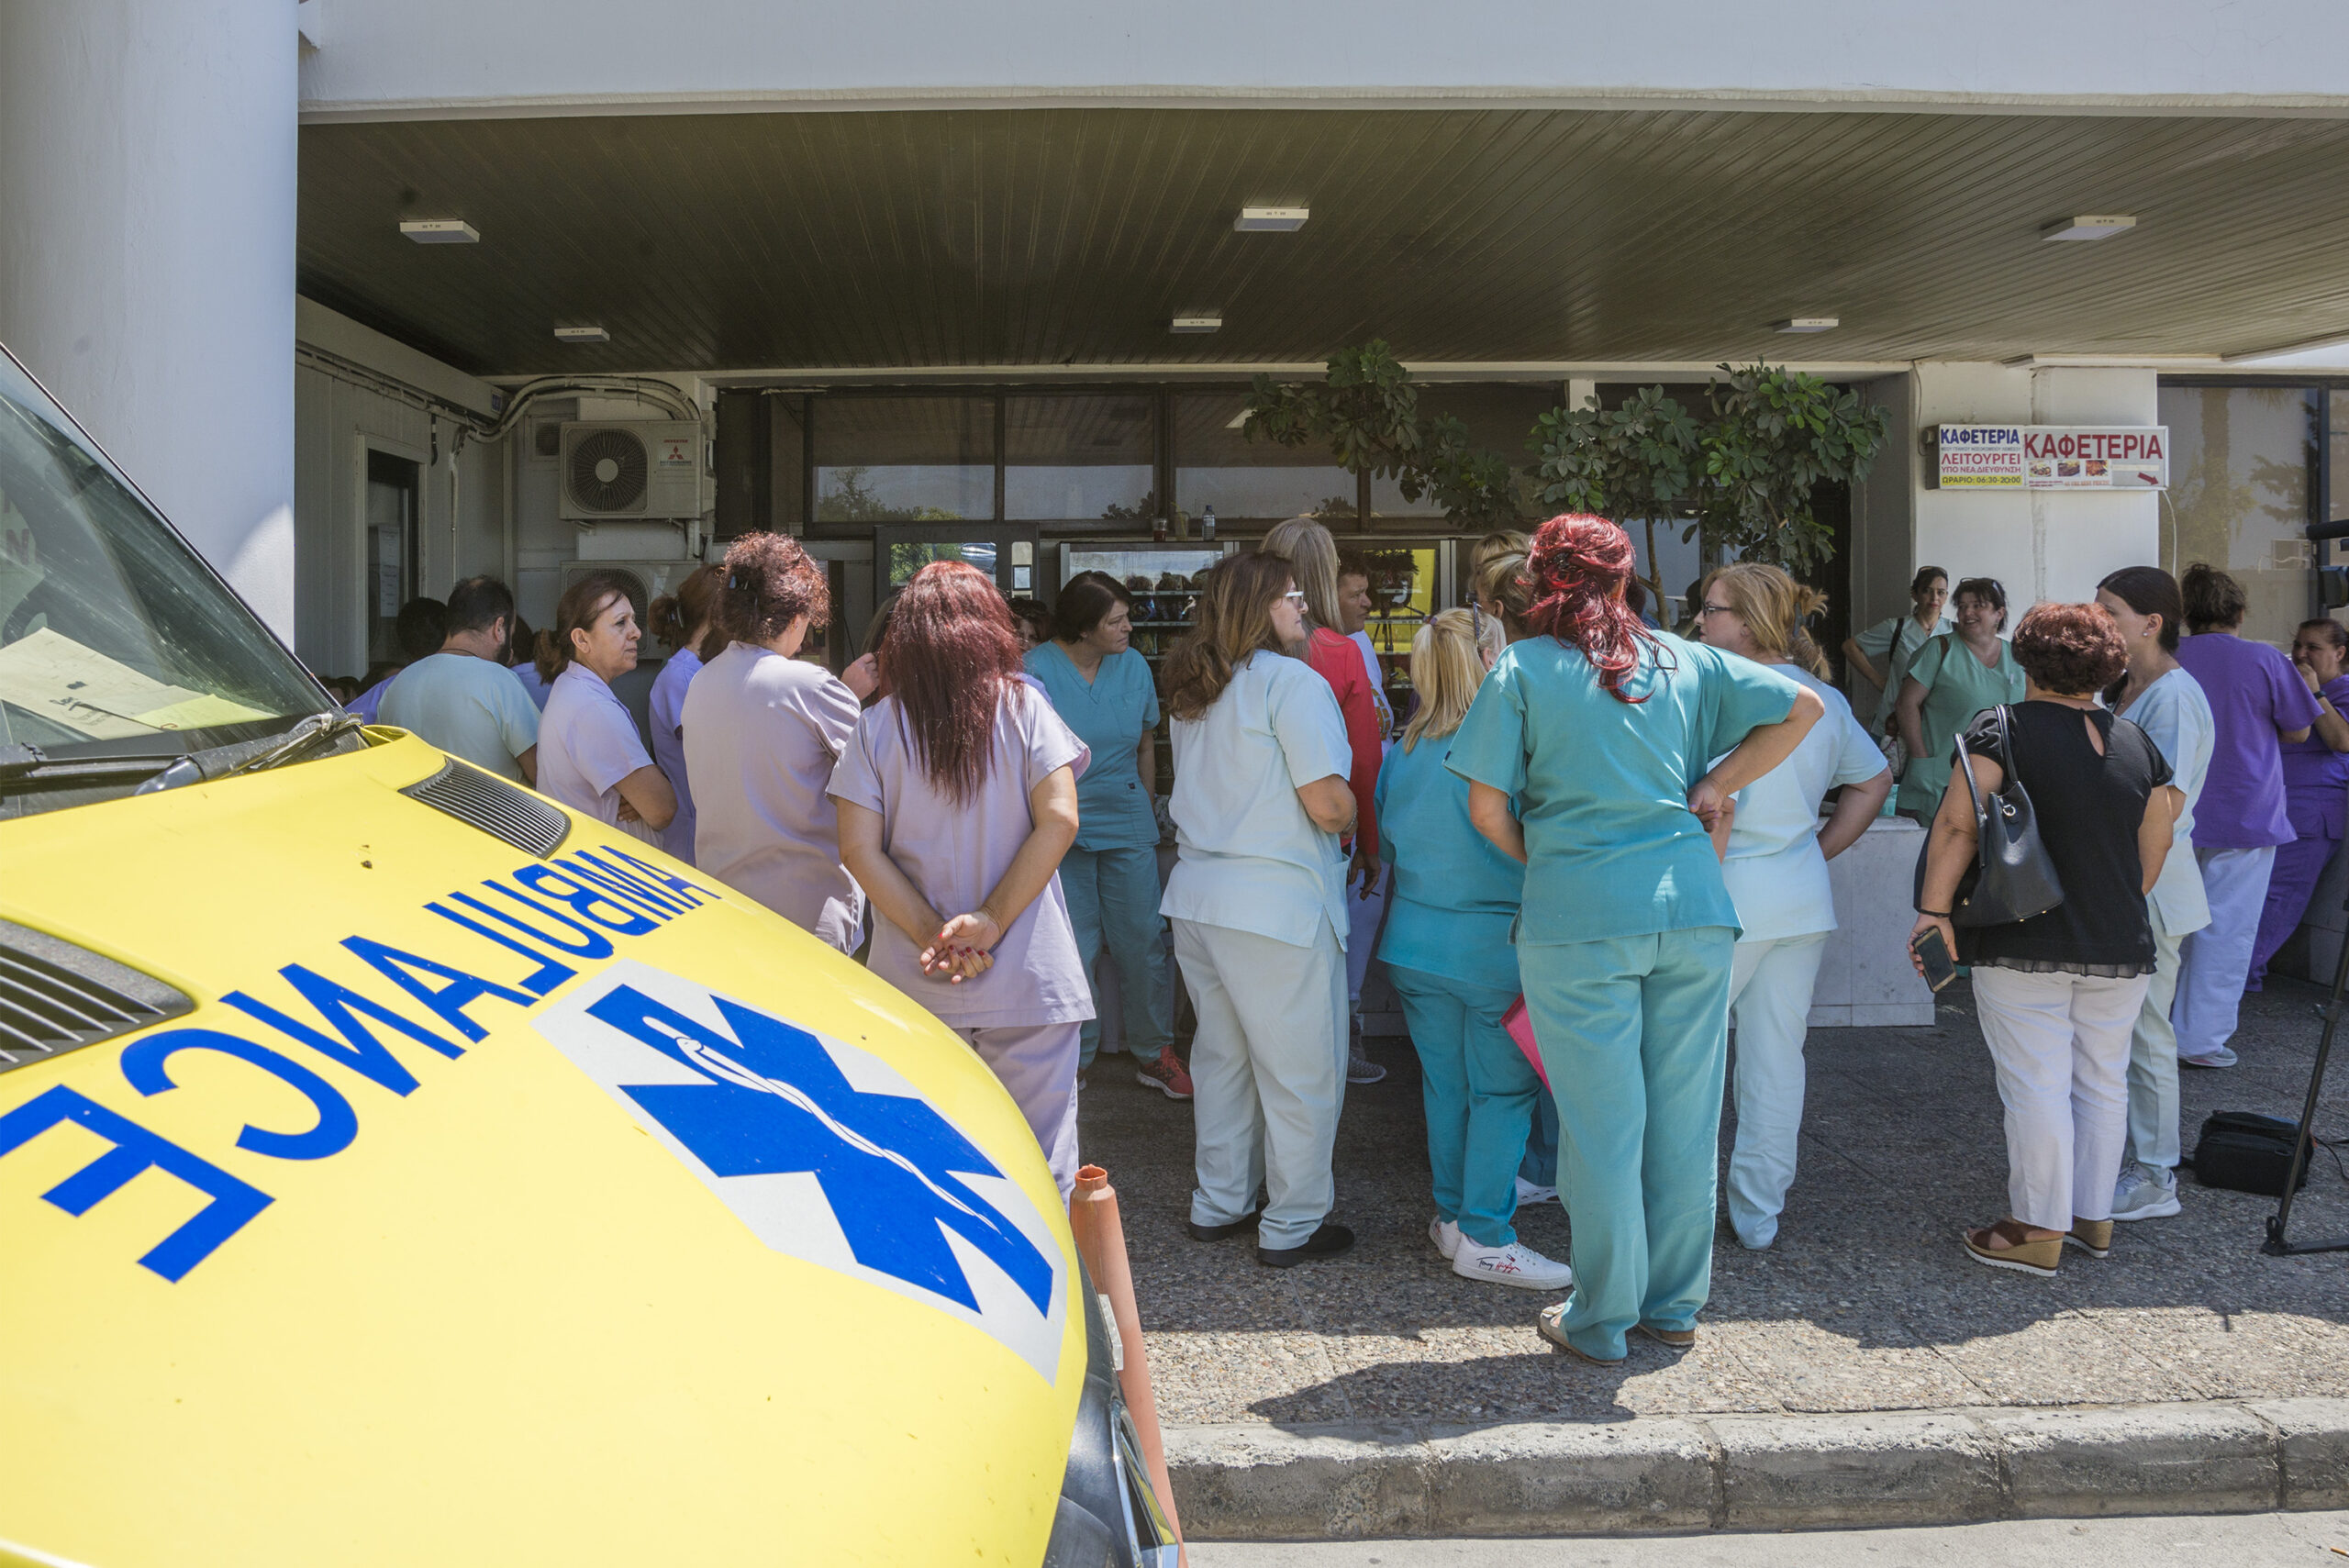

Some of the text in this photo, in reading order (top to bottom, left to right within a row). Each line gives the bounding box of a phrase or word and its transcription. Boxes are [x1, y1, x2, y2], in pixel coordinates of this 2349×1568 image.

[1940, 428, 2020, 444] ΚΑΦΕΤΕΡΙΑ
[2024, 433, 2163, 459] ΚΑΦΕΤΕΡΙΑ
[1941, 453, 2020, 465] ΛΕΙΤΟΥΡΓΕΙ
[1475, 1257, 1500, 1271] Tommy
